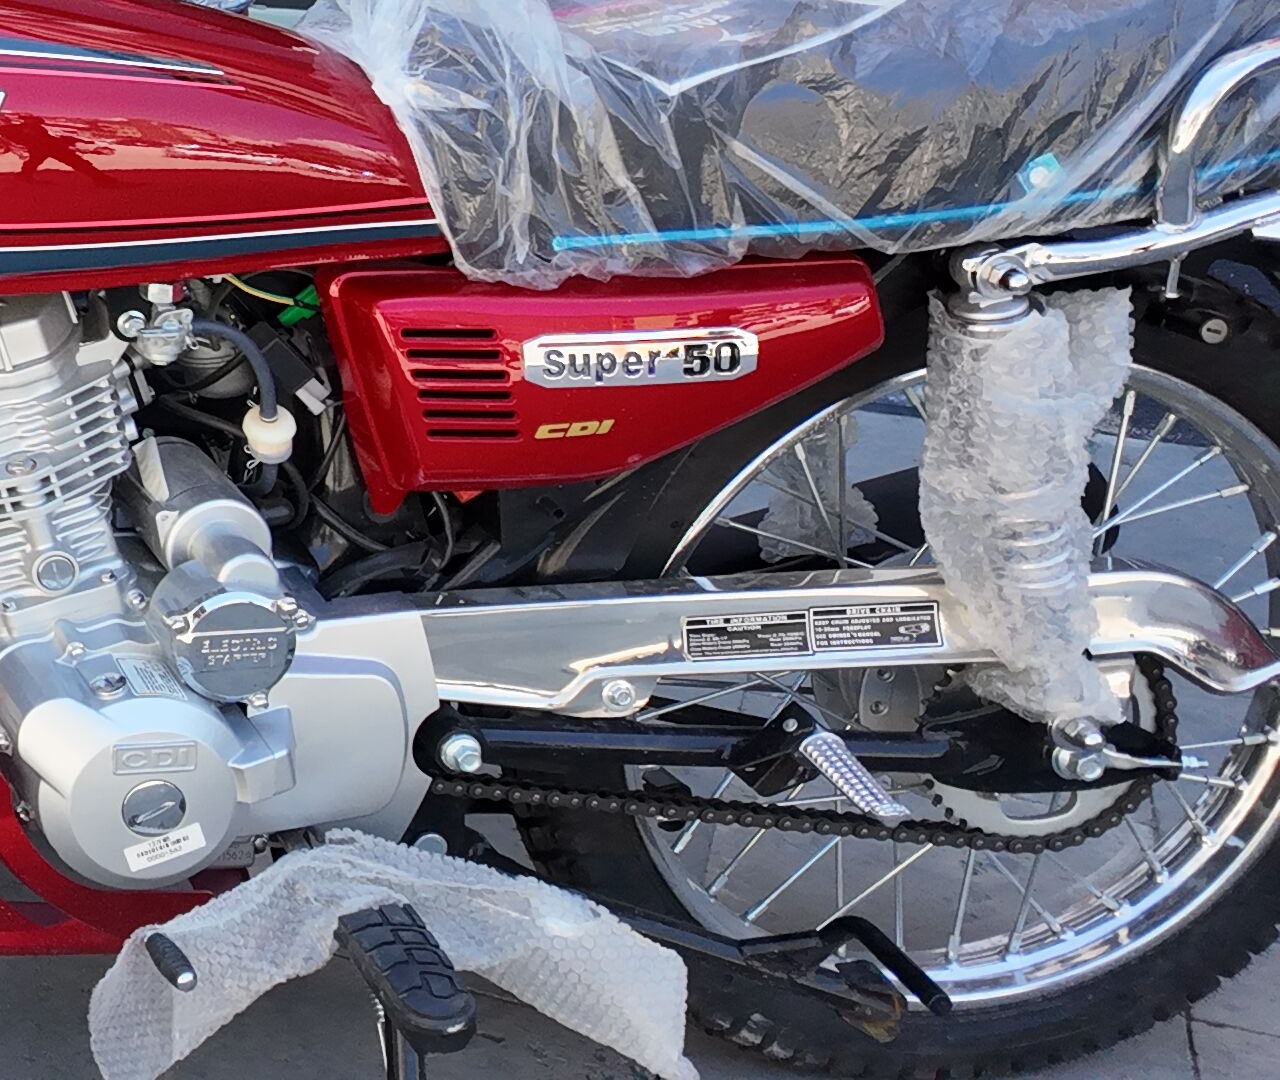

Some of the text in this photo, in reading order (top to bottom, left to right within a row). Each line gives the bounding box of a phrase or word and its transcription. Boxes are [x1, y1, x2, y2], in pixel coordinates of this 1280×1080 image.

[542, 341, 741, 383] Super 50
[534, 419, 615, 440] CDI
[122, 747, 189, 769] CDI
